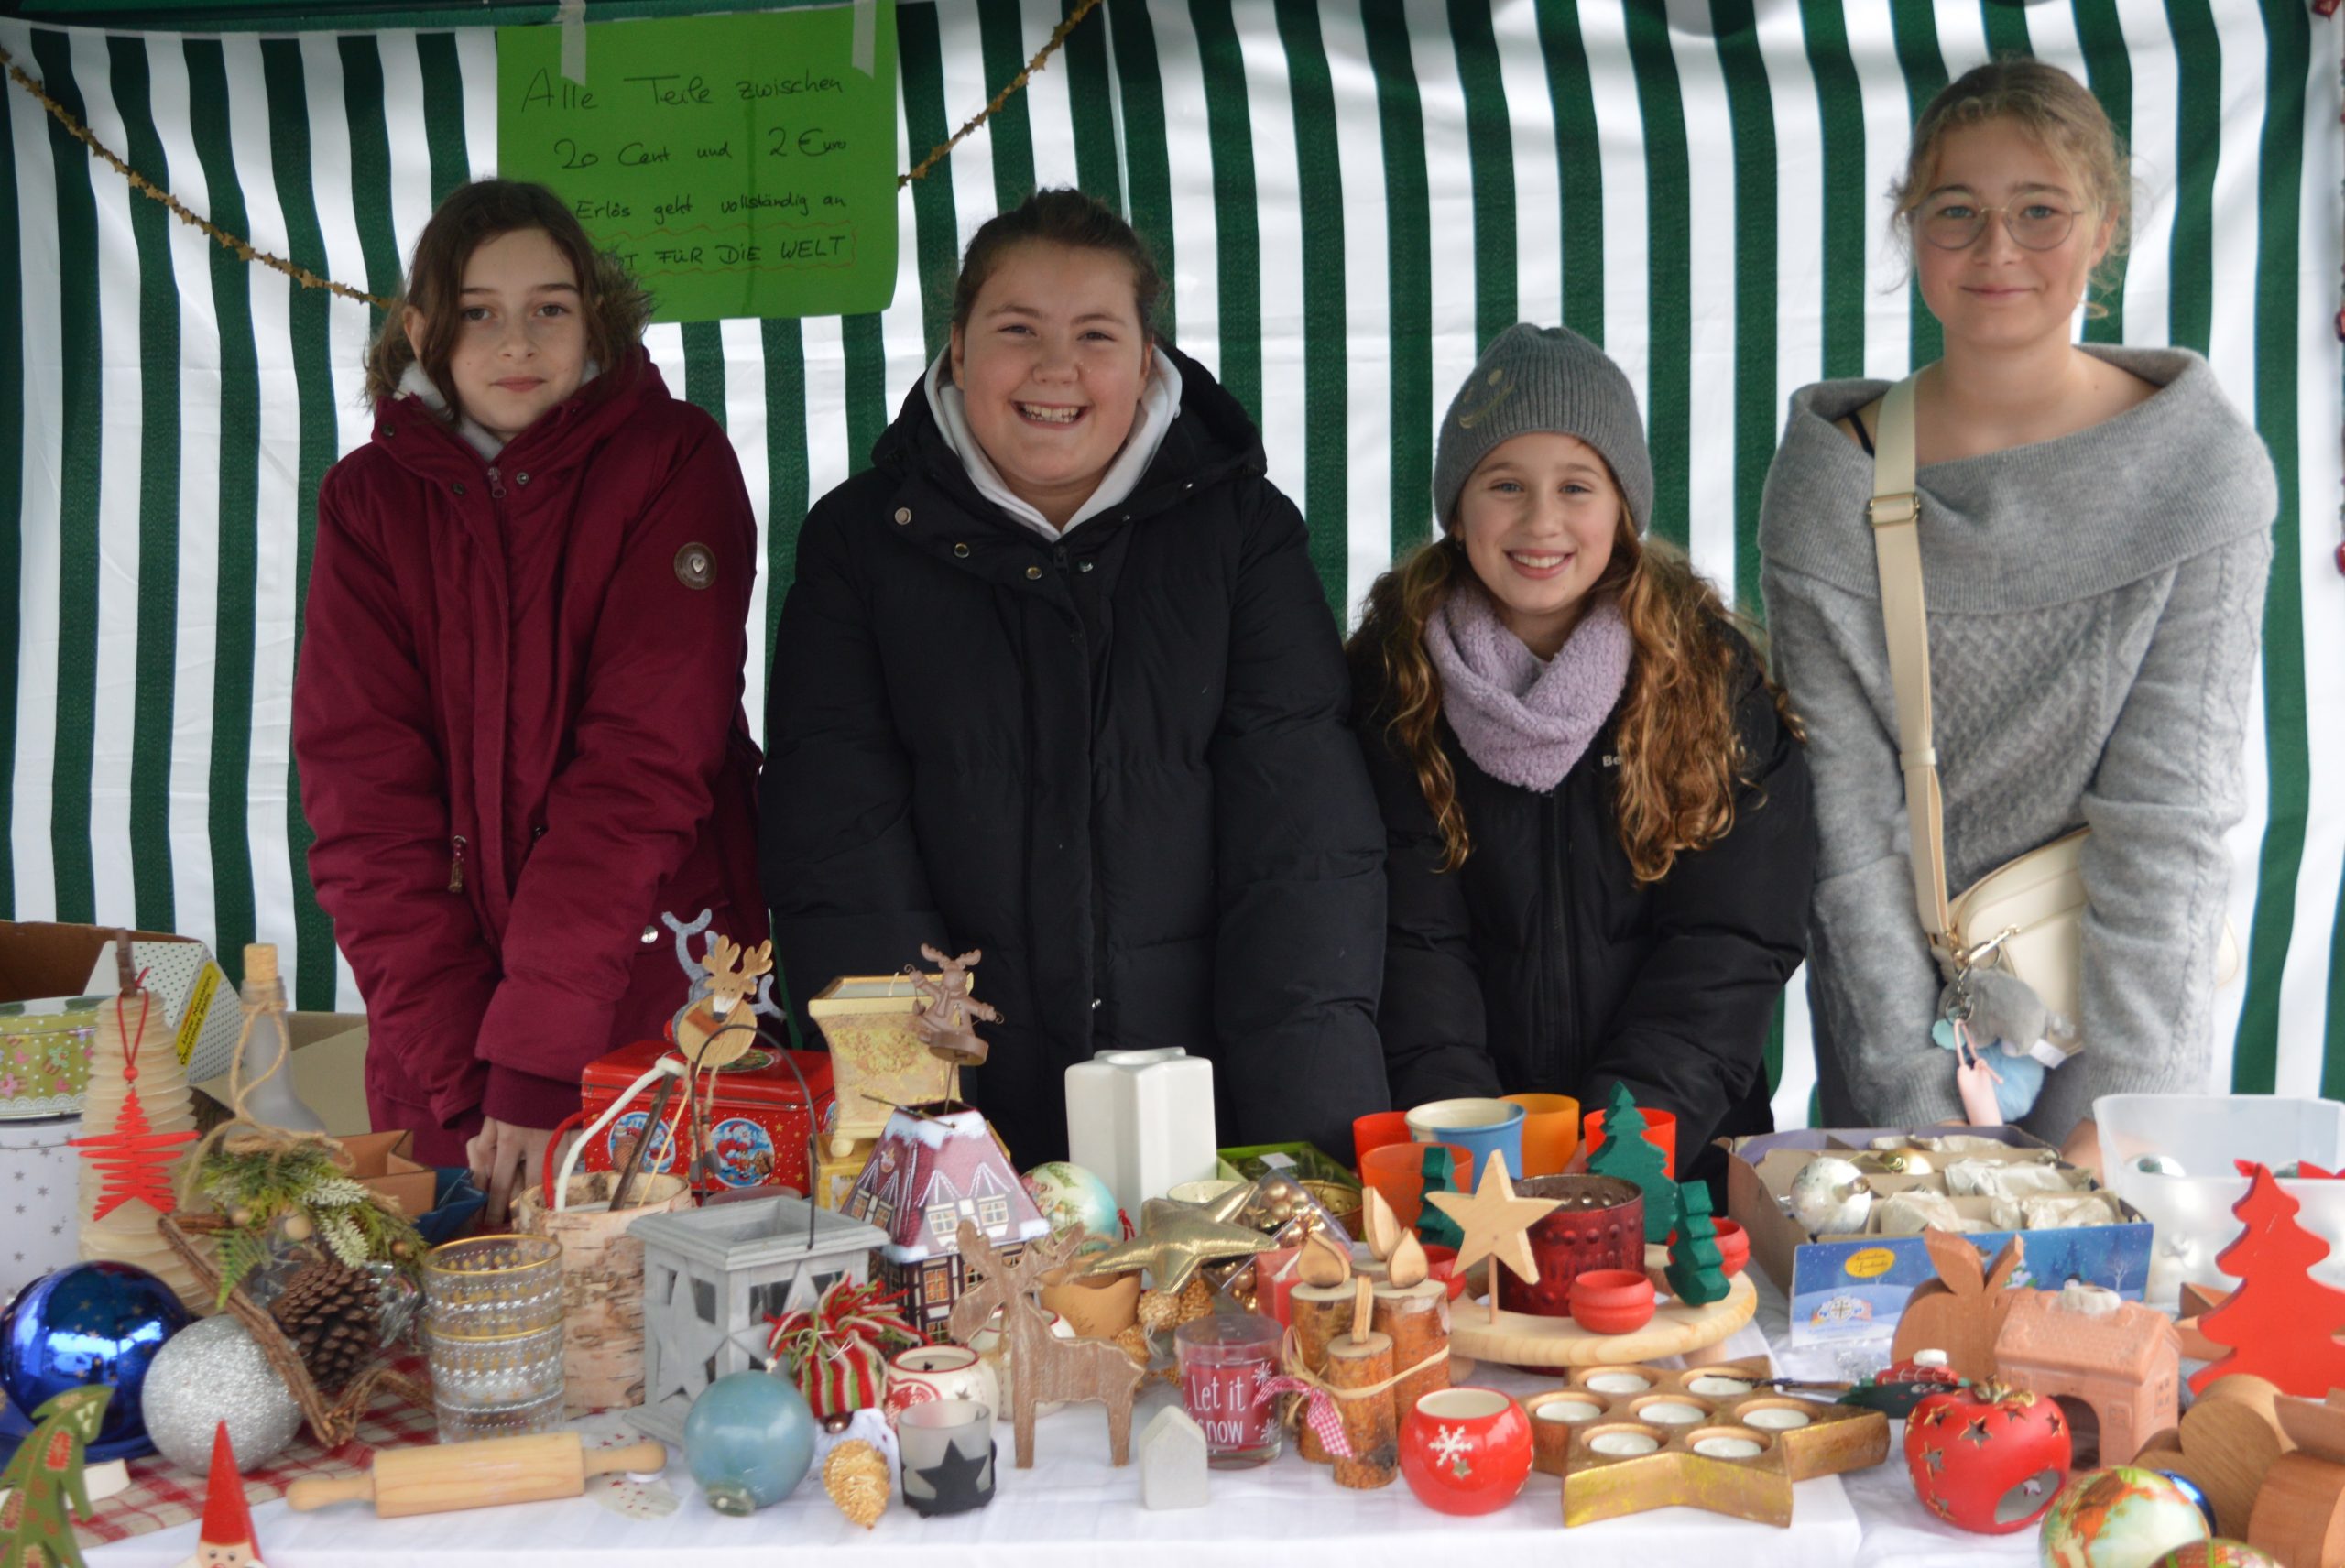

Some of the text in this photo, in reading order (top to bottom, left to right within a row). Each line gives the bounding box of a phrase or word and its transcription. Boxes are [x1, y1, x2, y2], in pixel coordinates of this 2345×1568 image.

[521, 68, 844, 113] Alle Teile zwischen
[553, 139, 599, 169] 20
[617, 142, 671, 167] Cent
[697, 141, 732, 159] und
[768, 127, 787, 157] 2
[575, 191, 846, 225] Erlös geht vollständig an
[780, 235, 845, 260] WELT
[1191, 1374, 1246, 1412] Let it
